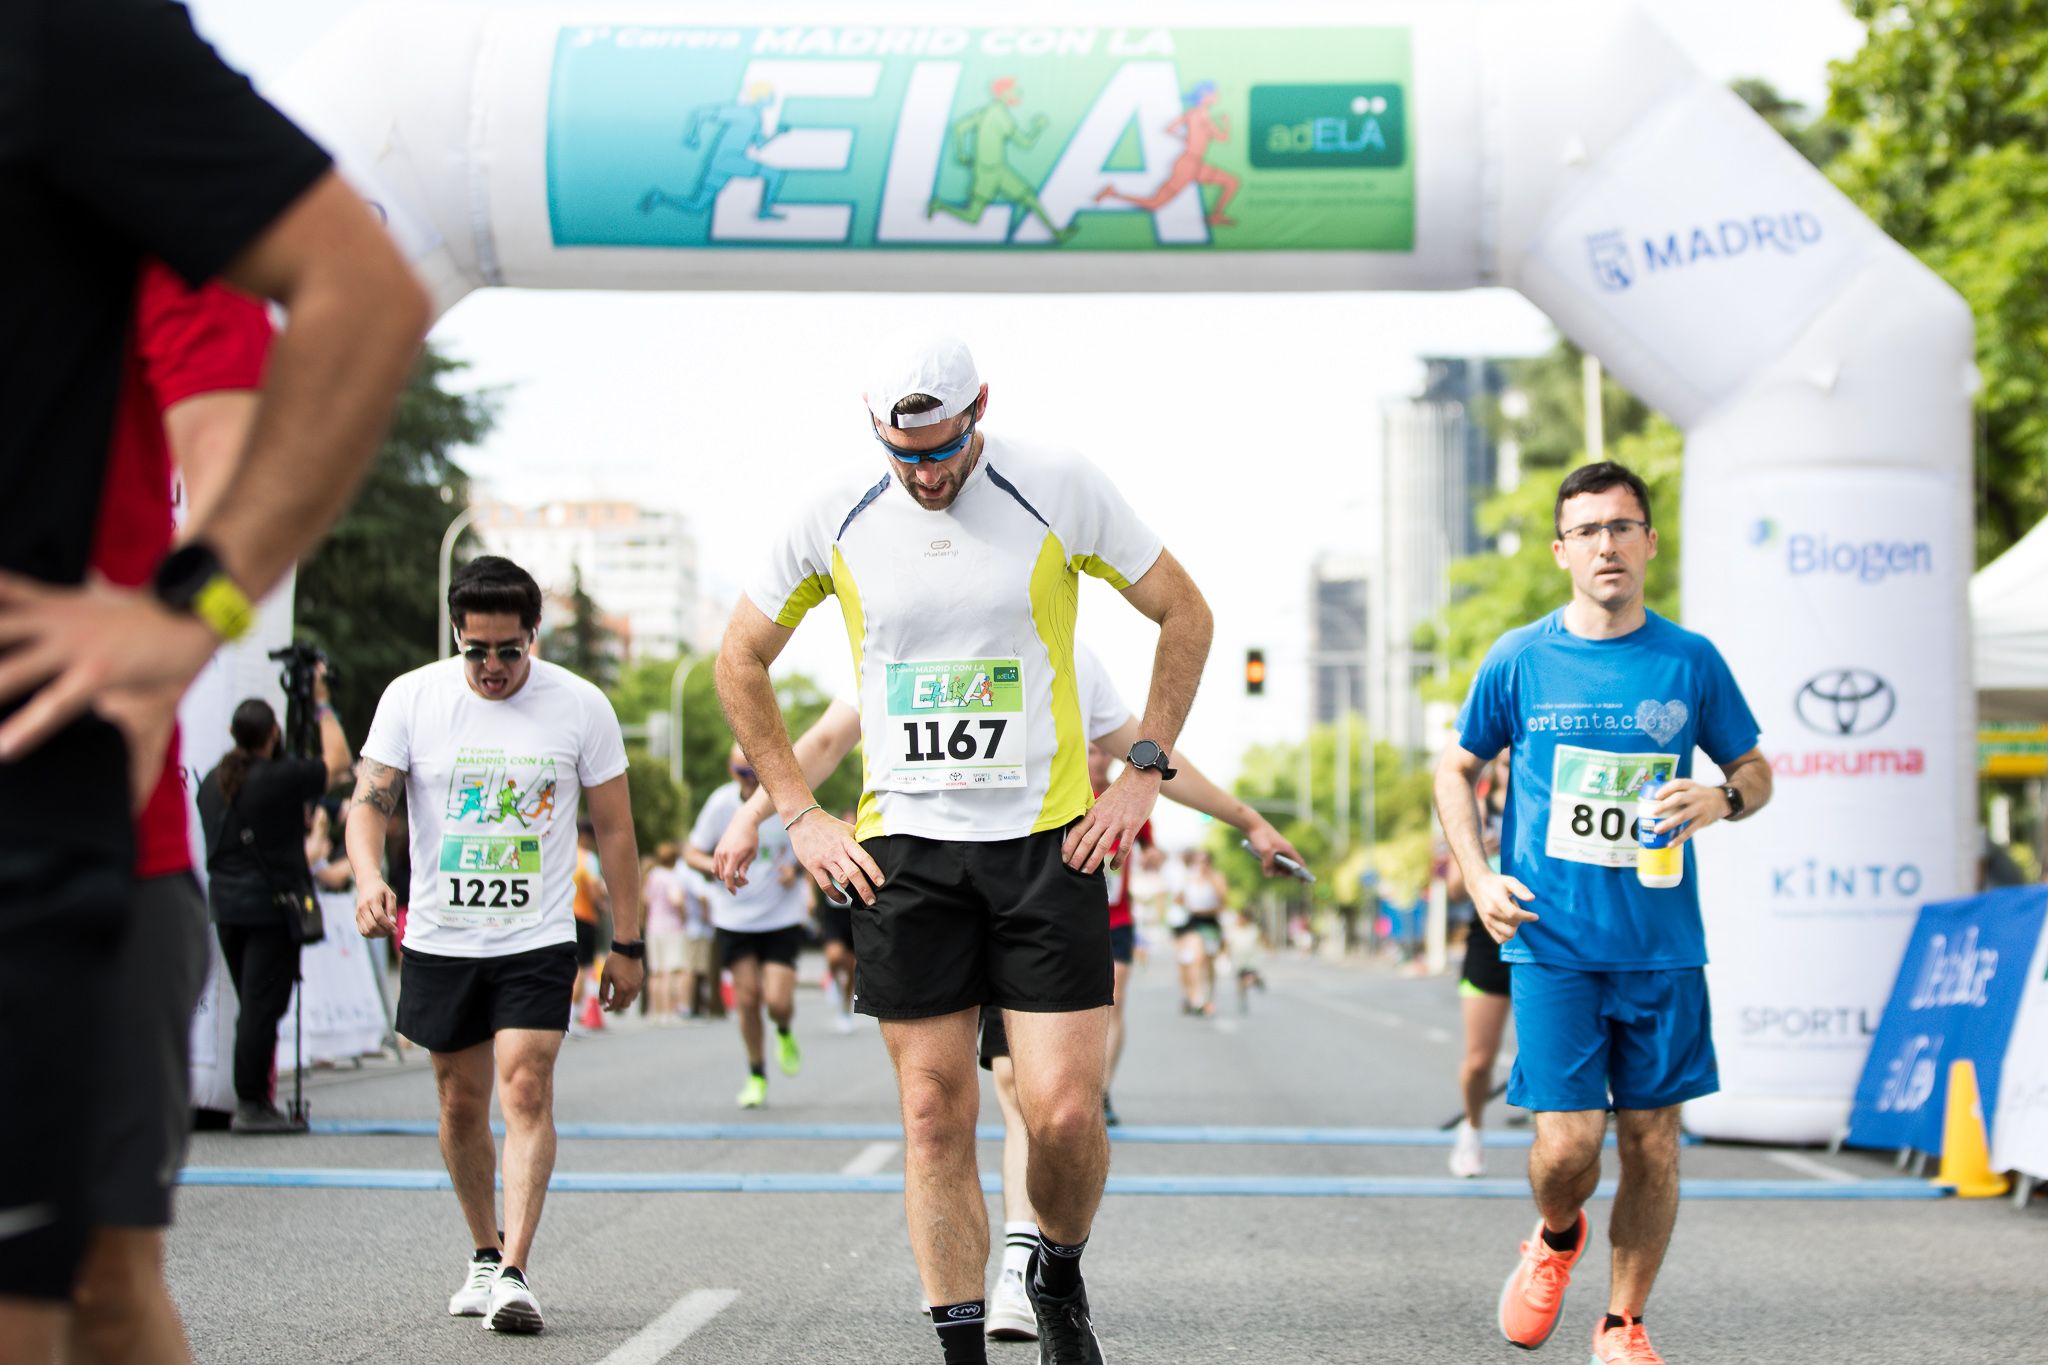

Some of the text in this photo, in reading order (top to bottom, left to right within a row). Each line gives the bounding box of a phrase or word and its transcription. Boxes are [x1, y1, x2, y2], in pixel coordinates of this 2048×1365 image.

[614, 29, 741, 49] Carrera
[752, 27, 969, 54] MADRID
[981, 27, 1098, 54] CON
[1108, 27, 1177, 54] LA
[709, 59, 1212, 244] ELA
[1642, 210, 1823, 271] MADRID
[1786, 533, 1933, 584] Biogen
[912, 673, 993, 709] ELA
[904, 720, 1008, 761] 1167
[456, 756, 555, 765] MADRID CON LA
[459, 844, 520, 870] ELA
[449, 877, 530, 908] 1225
